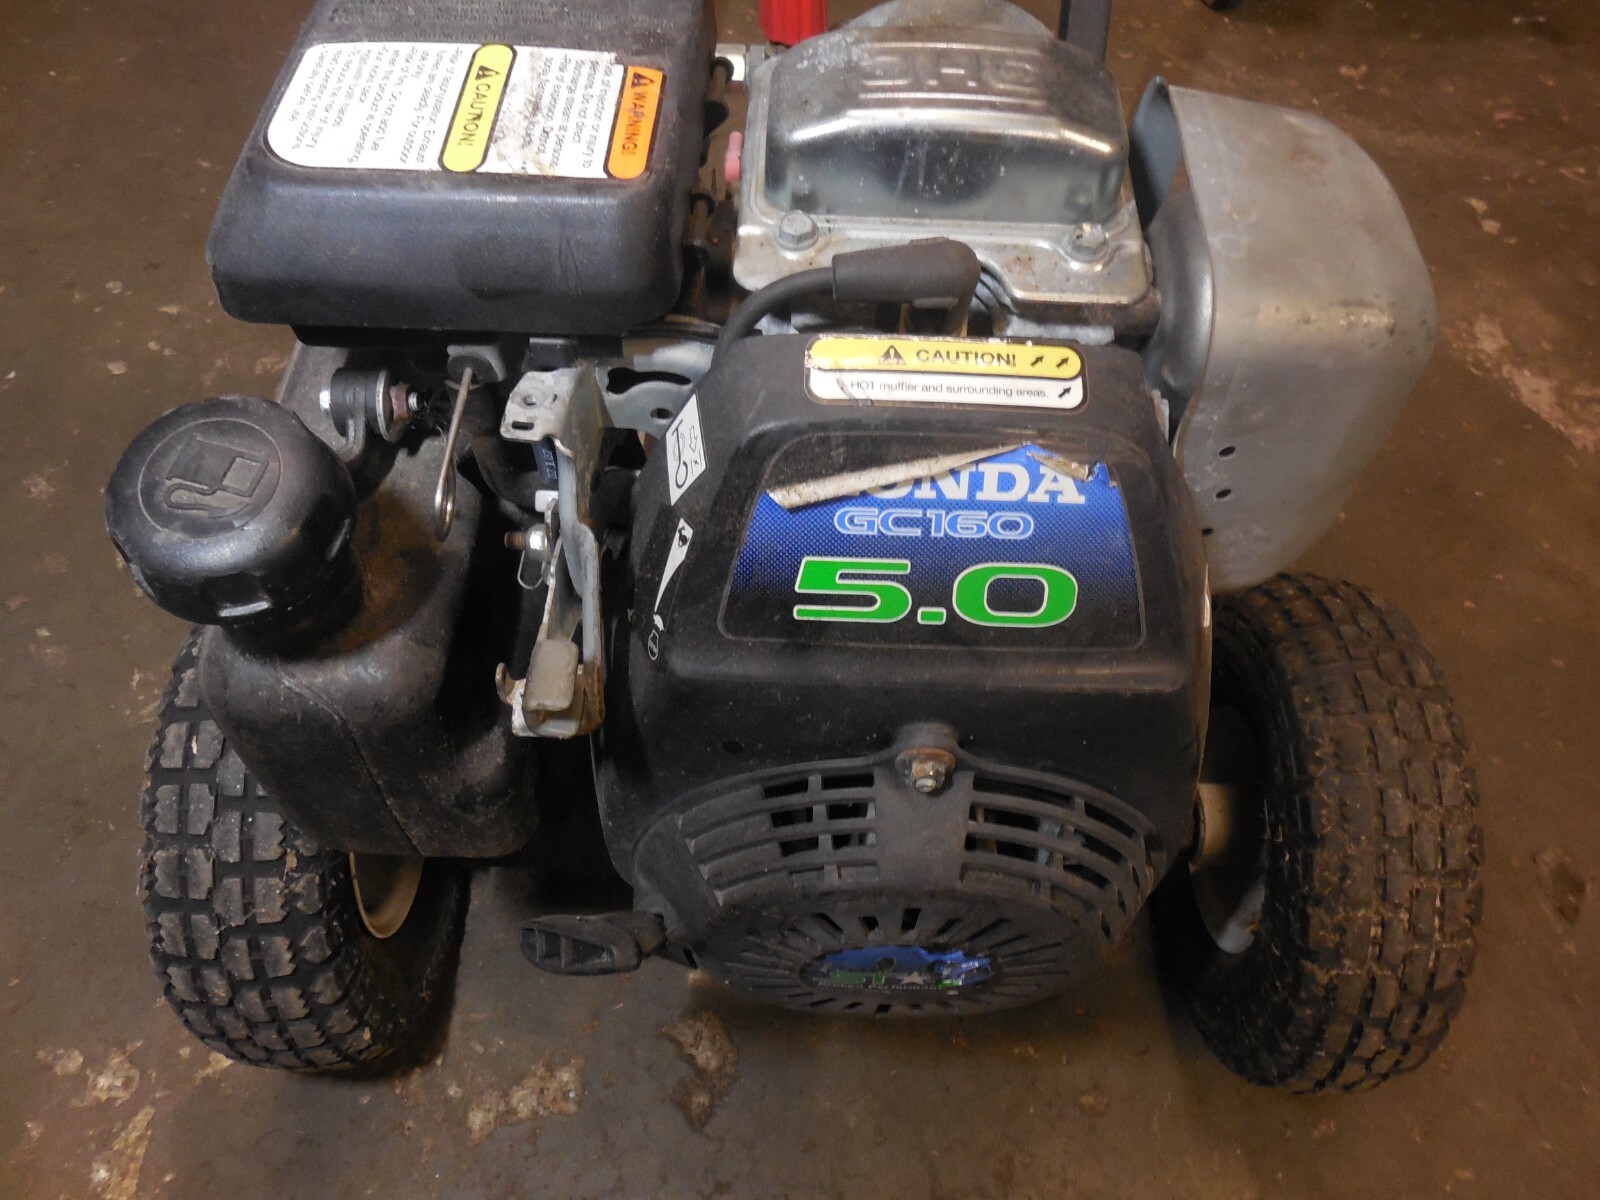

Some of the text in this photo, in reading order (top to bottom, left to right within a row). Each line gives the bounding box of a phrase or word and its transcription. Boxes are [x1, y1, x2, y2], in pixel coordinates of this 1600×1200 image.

[457, 82, 492, 146] CAUTION!
[619, 91, 649, 155] WARNING!
[916, 349, 1017, 367] CAUTION!
[851, 381, 1049, 398] HOT muffler and surrounding areas.
[858, 462, 1085, 504] NDA
[833, 507, 1034, 540] GC160
[793, 556, 1078, 628] 5.0
